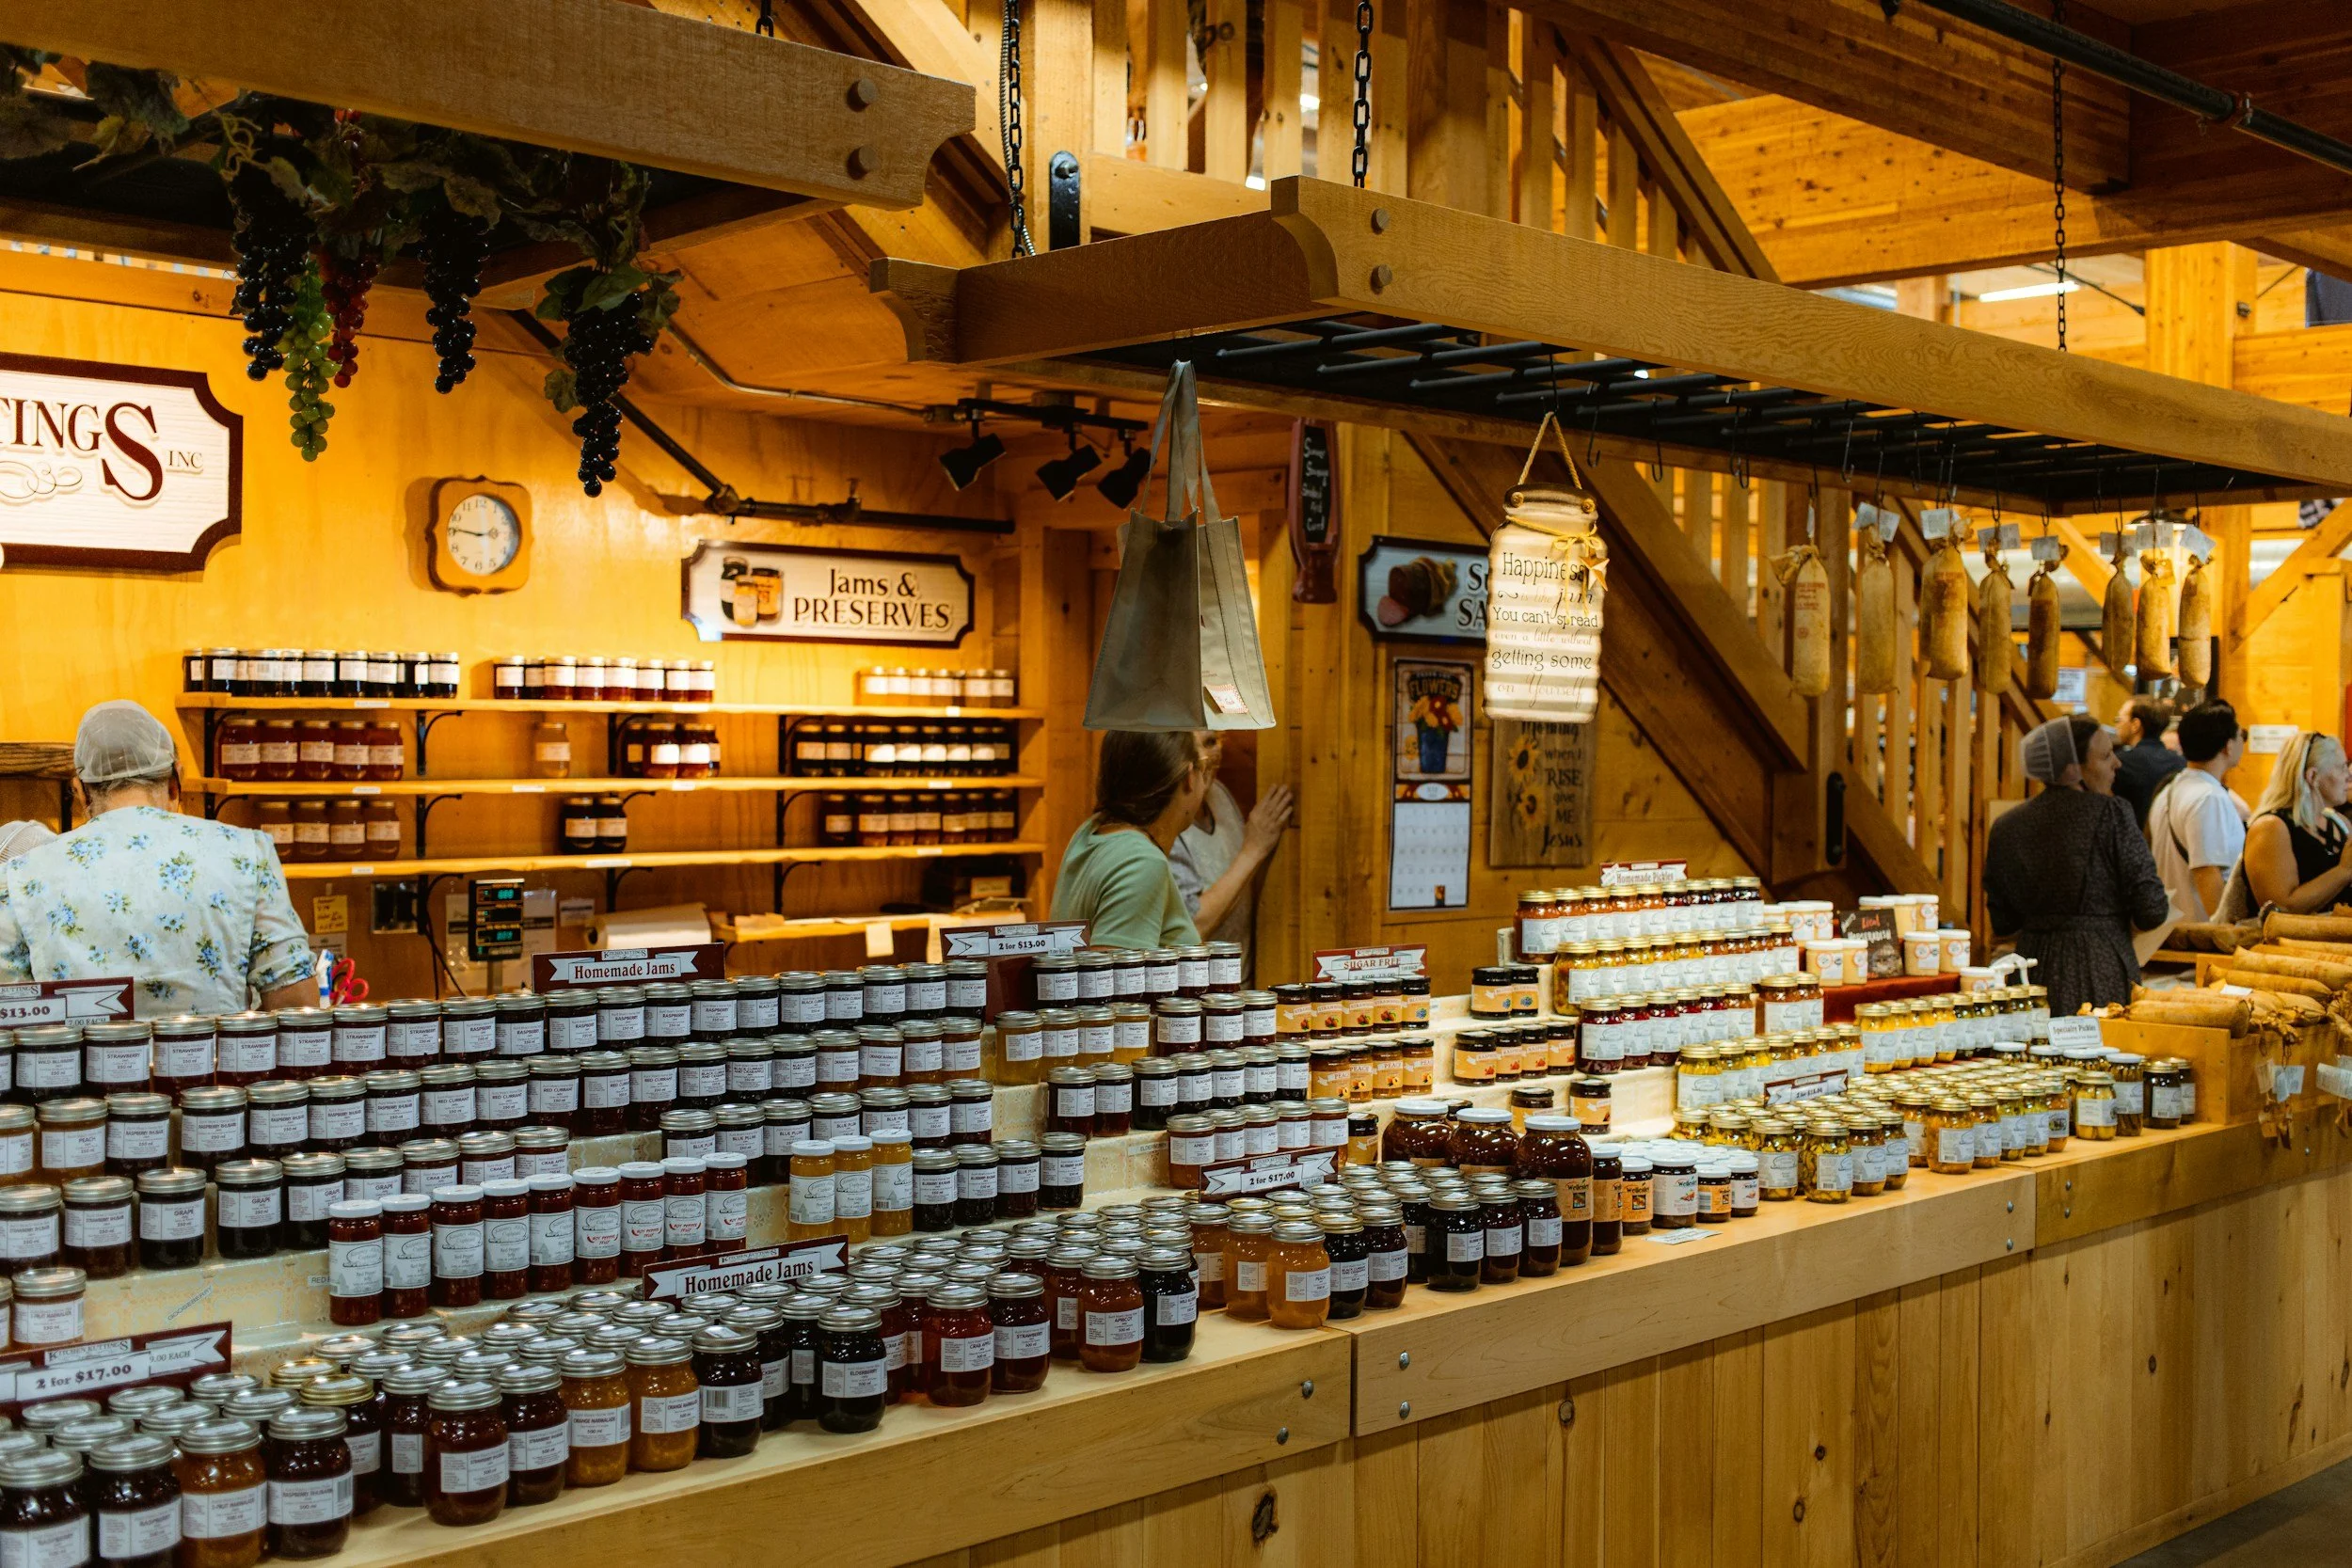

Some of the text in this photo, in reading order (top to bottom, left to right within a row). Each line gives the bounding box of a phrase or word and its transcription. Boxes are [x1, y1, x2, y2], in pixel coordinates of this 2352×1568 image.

[0, 398, 202, 500] INGS INC
[463, 502, 470, 512] 11
[475, 499, 486, 508] 12
[461, 556, 468, 564] 7
[1502, 552, 1586, 585] Happiness
[830, 567, 918, 598] Jams &
[793, 597, 950, 629] PRESERVES
[1493, 607, 1598, 629] You can't spread
[1492, 649, 1592, 671] getting some
[1545, 768, 1582, 787] RISE
[1556, 809, 1573, 824] ME
[1540, 825, 1582, 856] Jesus
[1617, 871, 1673, 883] Homemade Pickles
[1018, 940, 1046, 948] $13.00
[575, 960, 675, 979] Homemade Jams
[1344, 958, 1401, 969] SUGAR FREE
[0, 1006, 51, 1018] $13.00
[1256, 1176, 1266, 1184] for
[1268, 1171, 1295, 1182] $17.00
[685, 1260, 814, 1294] Homemade Jams
[49, 1340, 129, 1361] KITCHEN KUTTINGS
[150, 1351, 190, 1363] 9.00 EACH
[36, 1364, 132, 1389] 2 for $17.00
